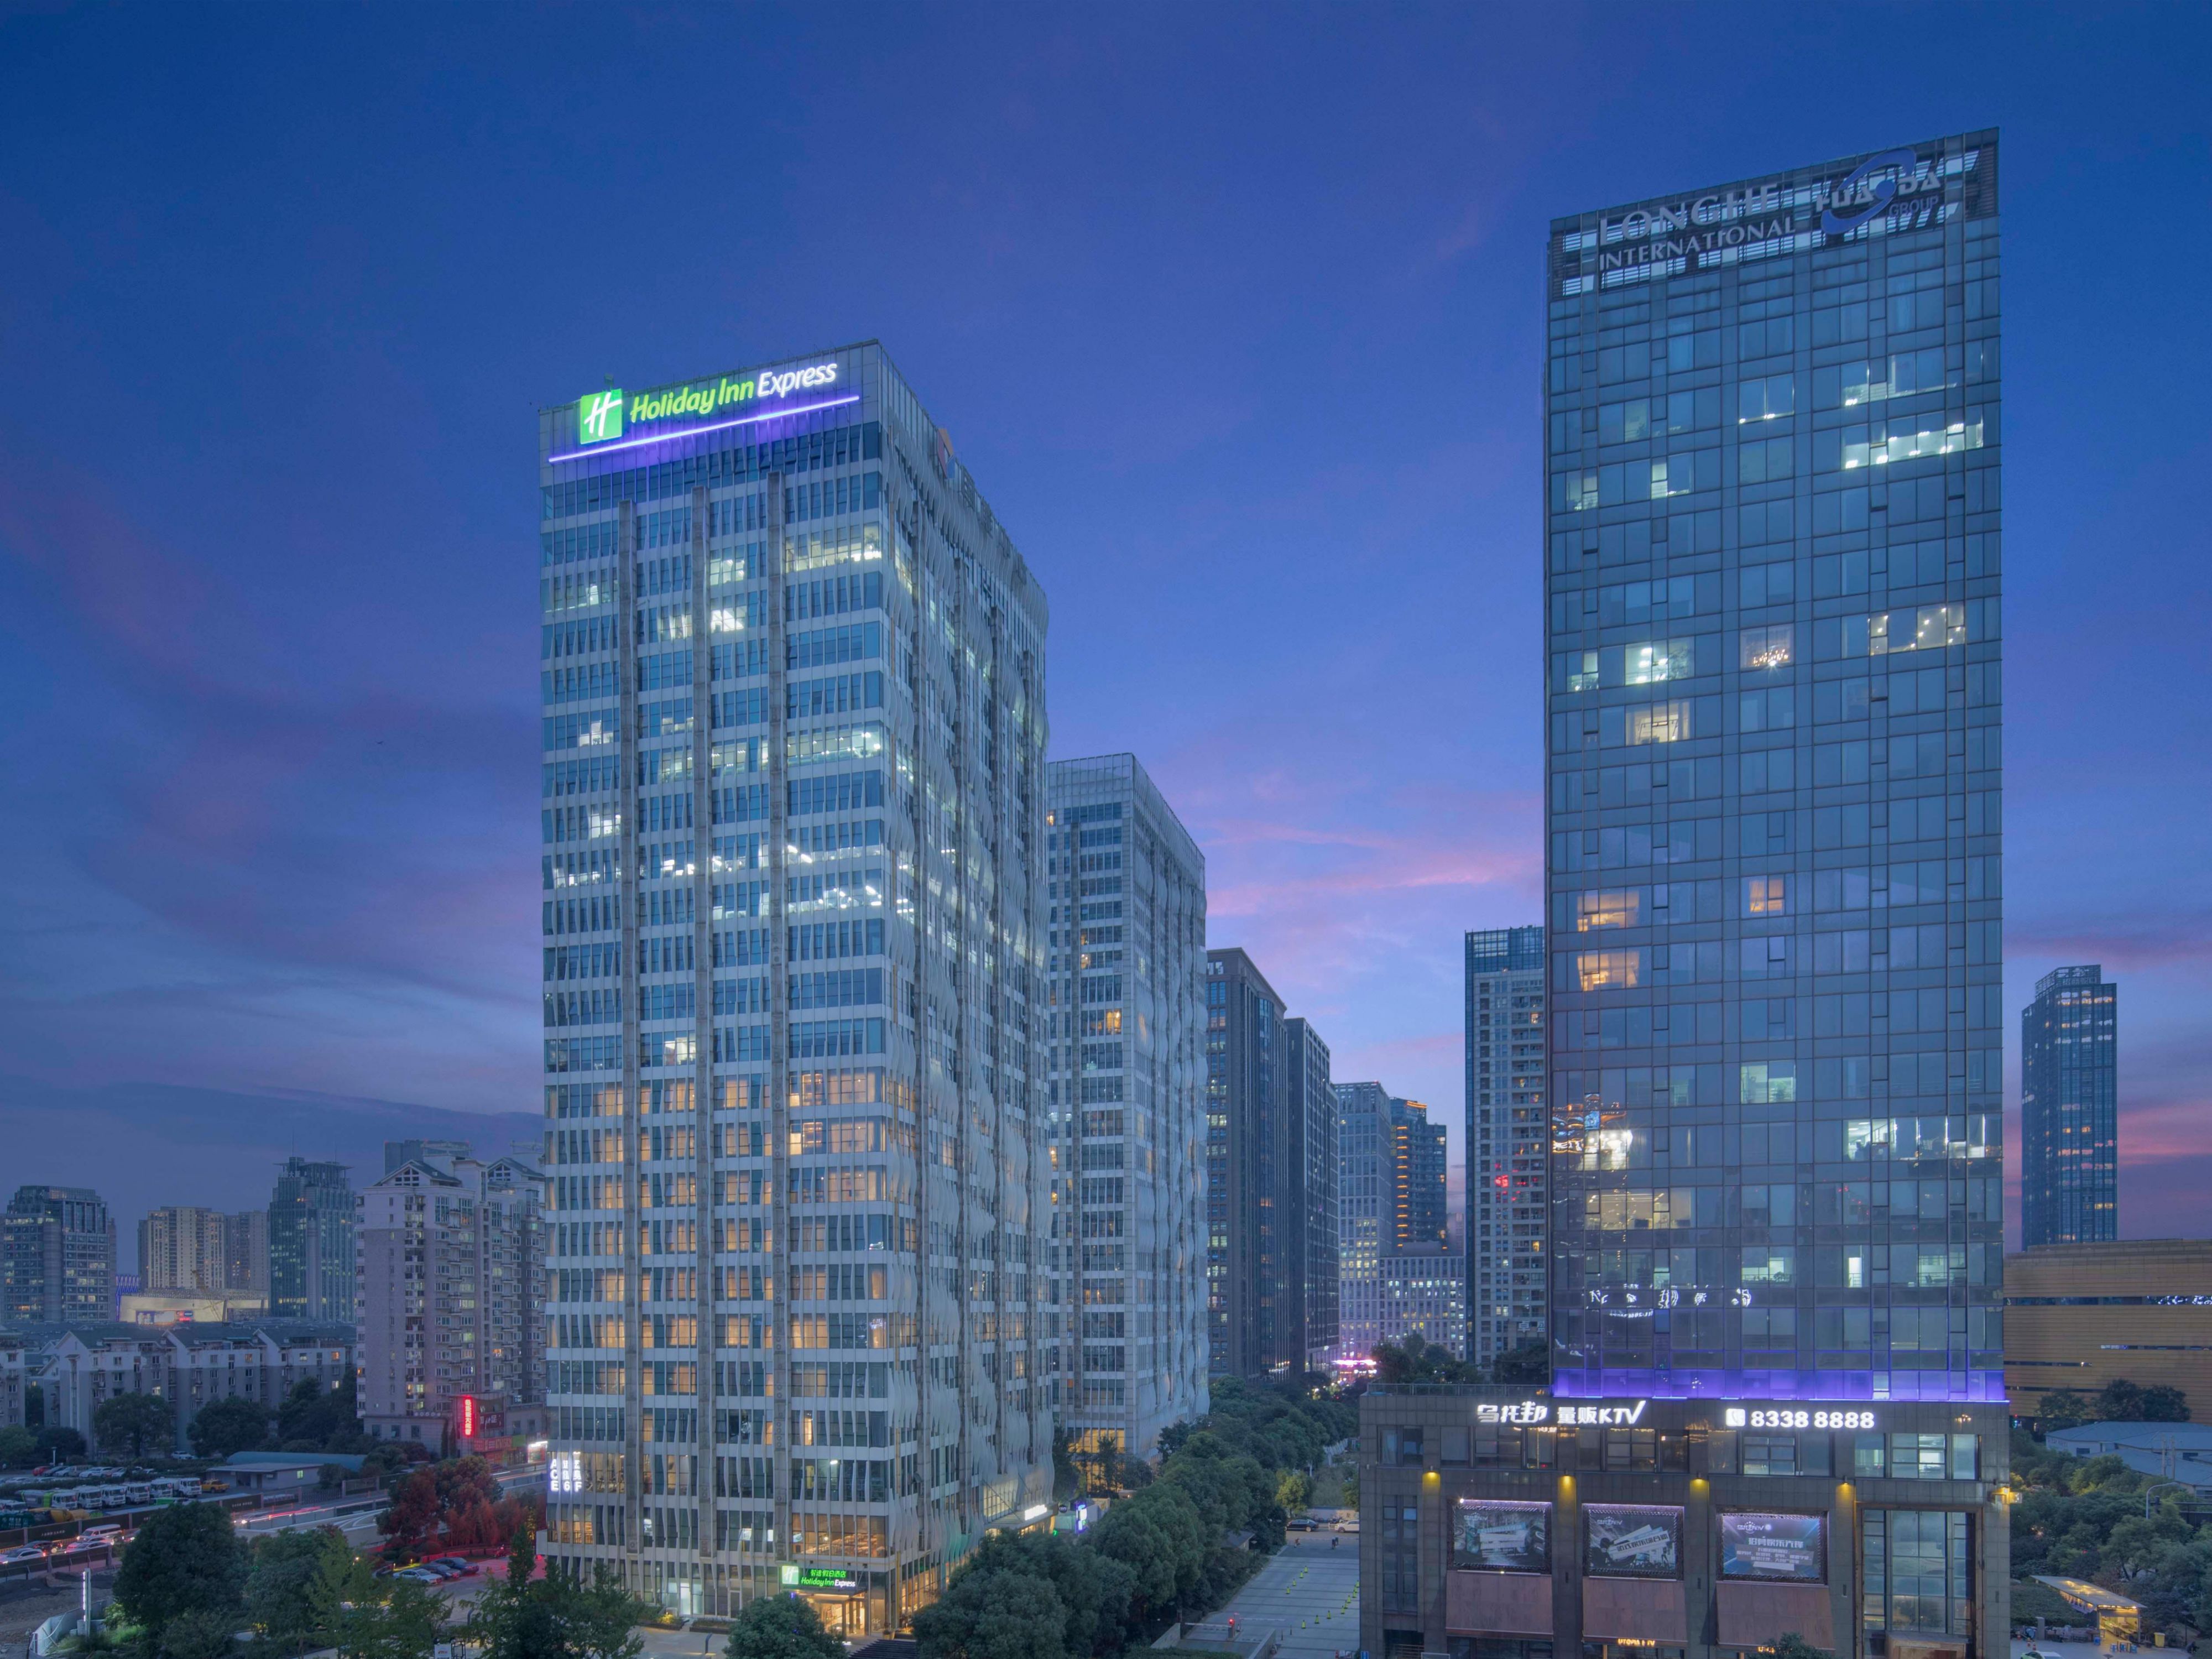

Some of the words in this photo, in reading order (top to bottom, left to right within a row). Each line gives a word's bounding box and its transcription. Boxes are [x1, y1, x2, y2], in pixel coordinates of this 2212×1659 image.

[1600, 183, 1778, 246] LONGHE
[1888, 195, 1939, 217] GROUP
[1599, 216, 1796, 271] INTERNATIONAL
[630, 387, 716, 423] Holiday
[718, 378, 754, 405] Inn
[757, 363, 837, 398] Express
[1477, 1401, 1547, 1423] 乌托邦
[1557, 1400, 1646, 1425] 量贩KTV
[1750, 1411, 1809, 1428] 8338
[1814, 1411, 1875, 1428] 8888
[800, 1577, 825, 1587] Holiday
[825, 1578, 834, 1586] Inn
[834, 1579, 855, 1588] Express
